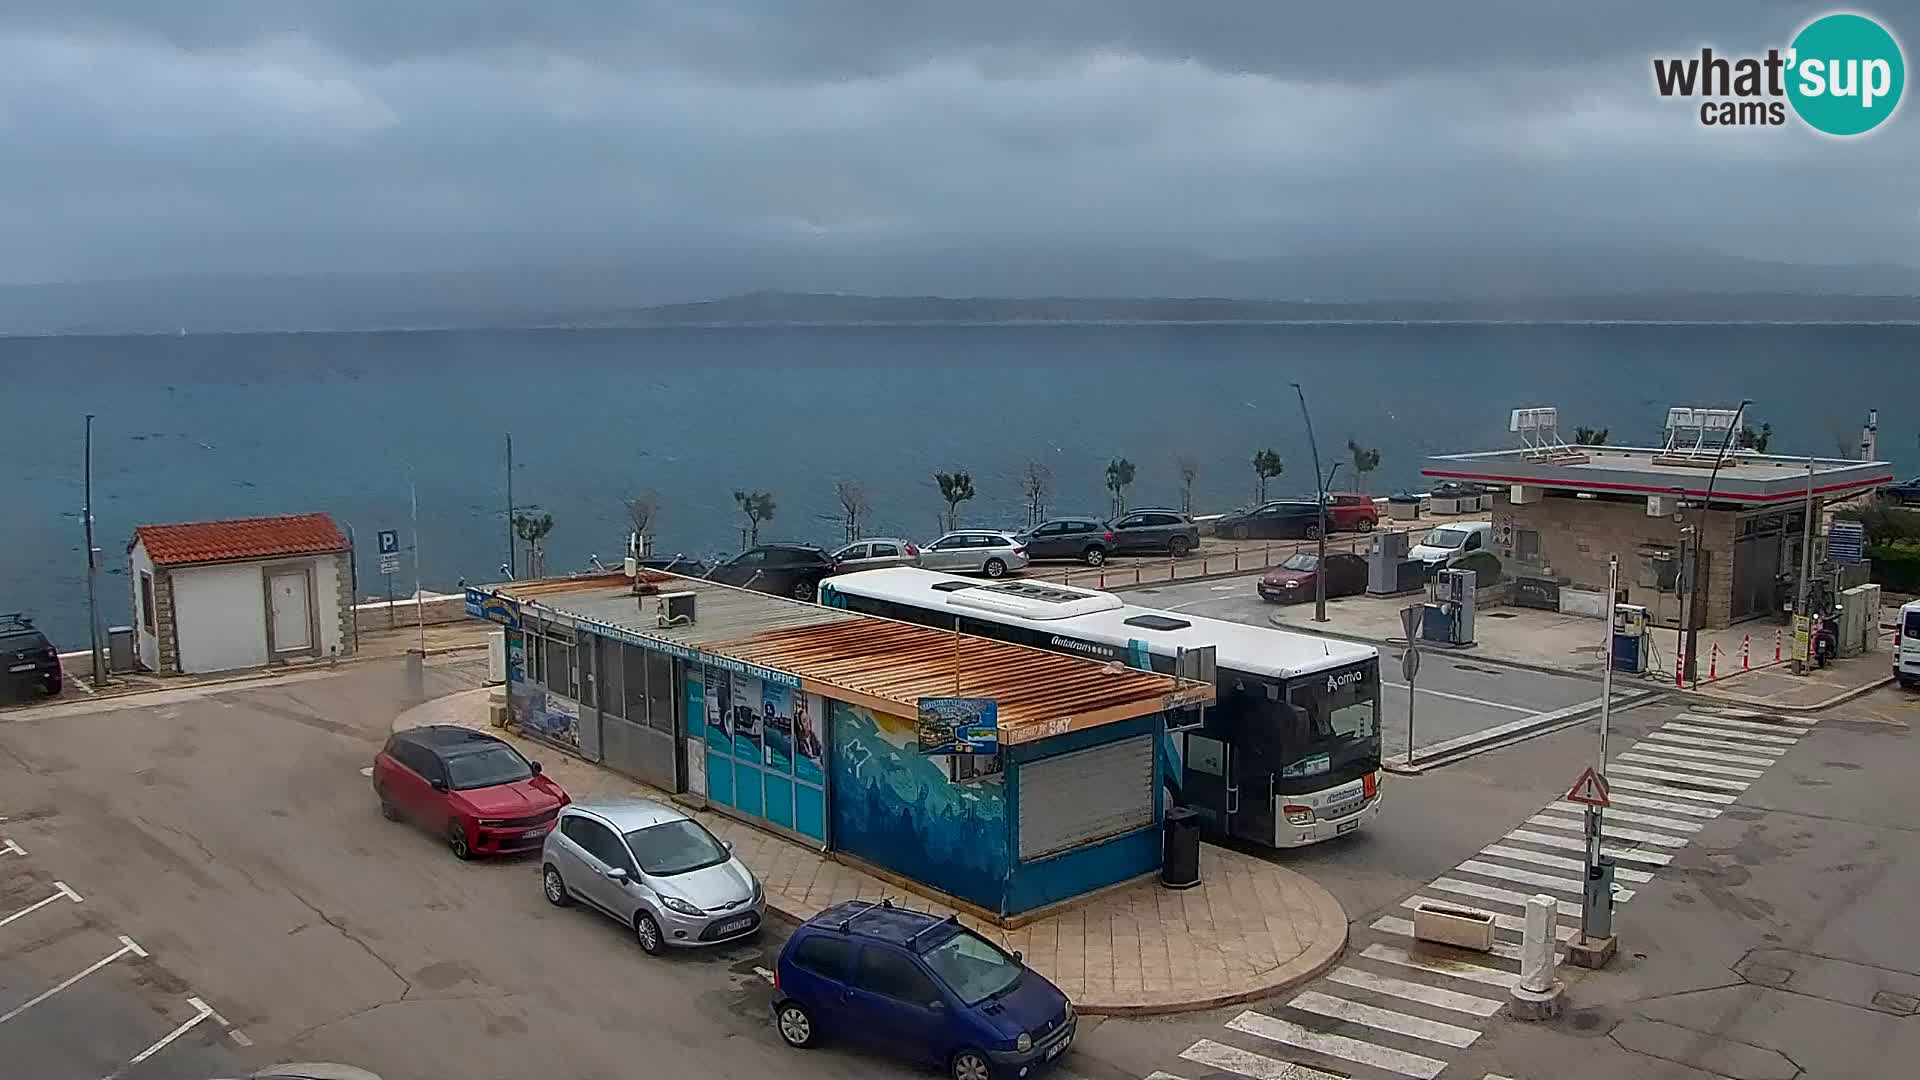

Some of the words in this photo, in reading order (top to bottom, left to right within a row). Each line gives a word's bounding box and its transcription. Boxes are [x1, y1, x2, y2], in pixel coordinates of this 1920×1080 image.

[383, 533, 394, 550] P
[714, 655, 744, 673] STATION
[746, 663, 771, 680] TICKET
[773, 671, 799, 687] OFFICE
